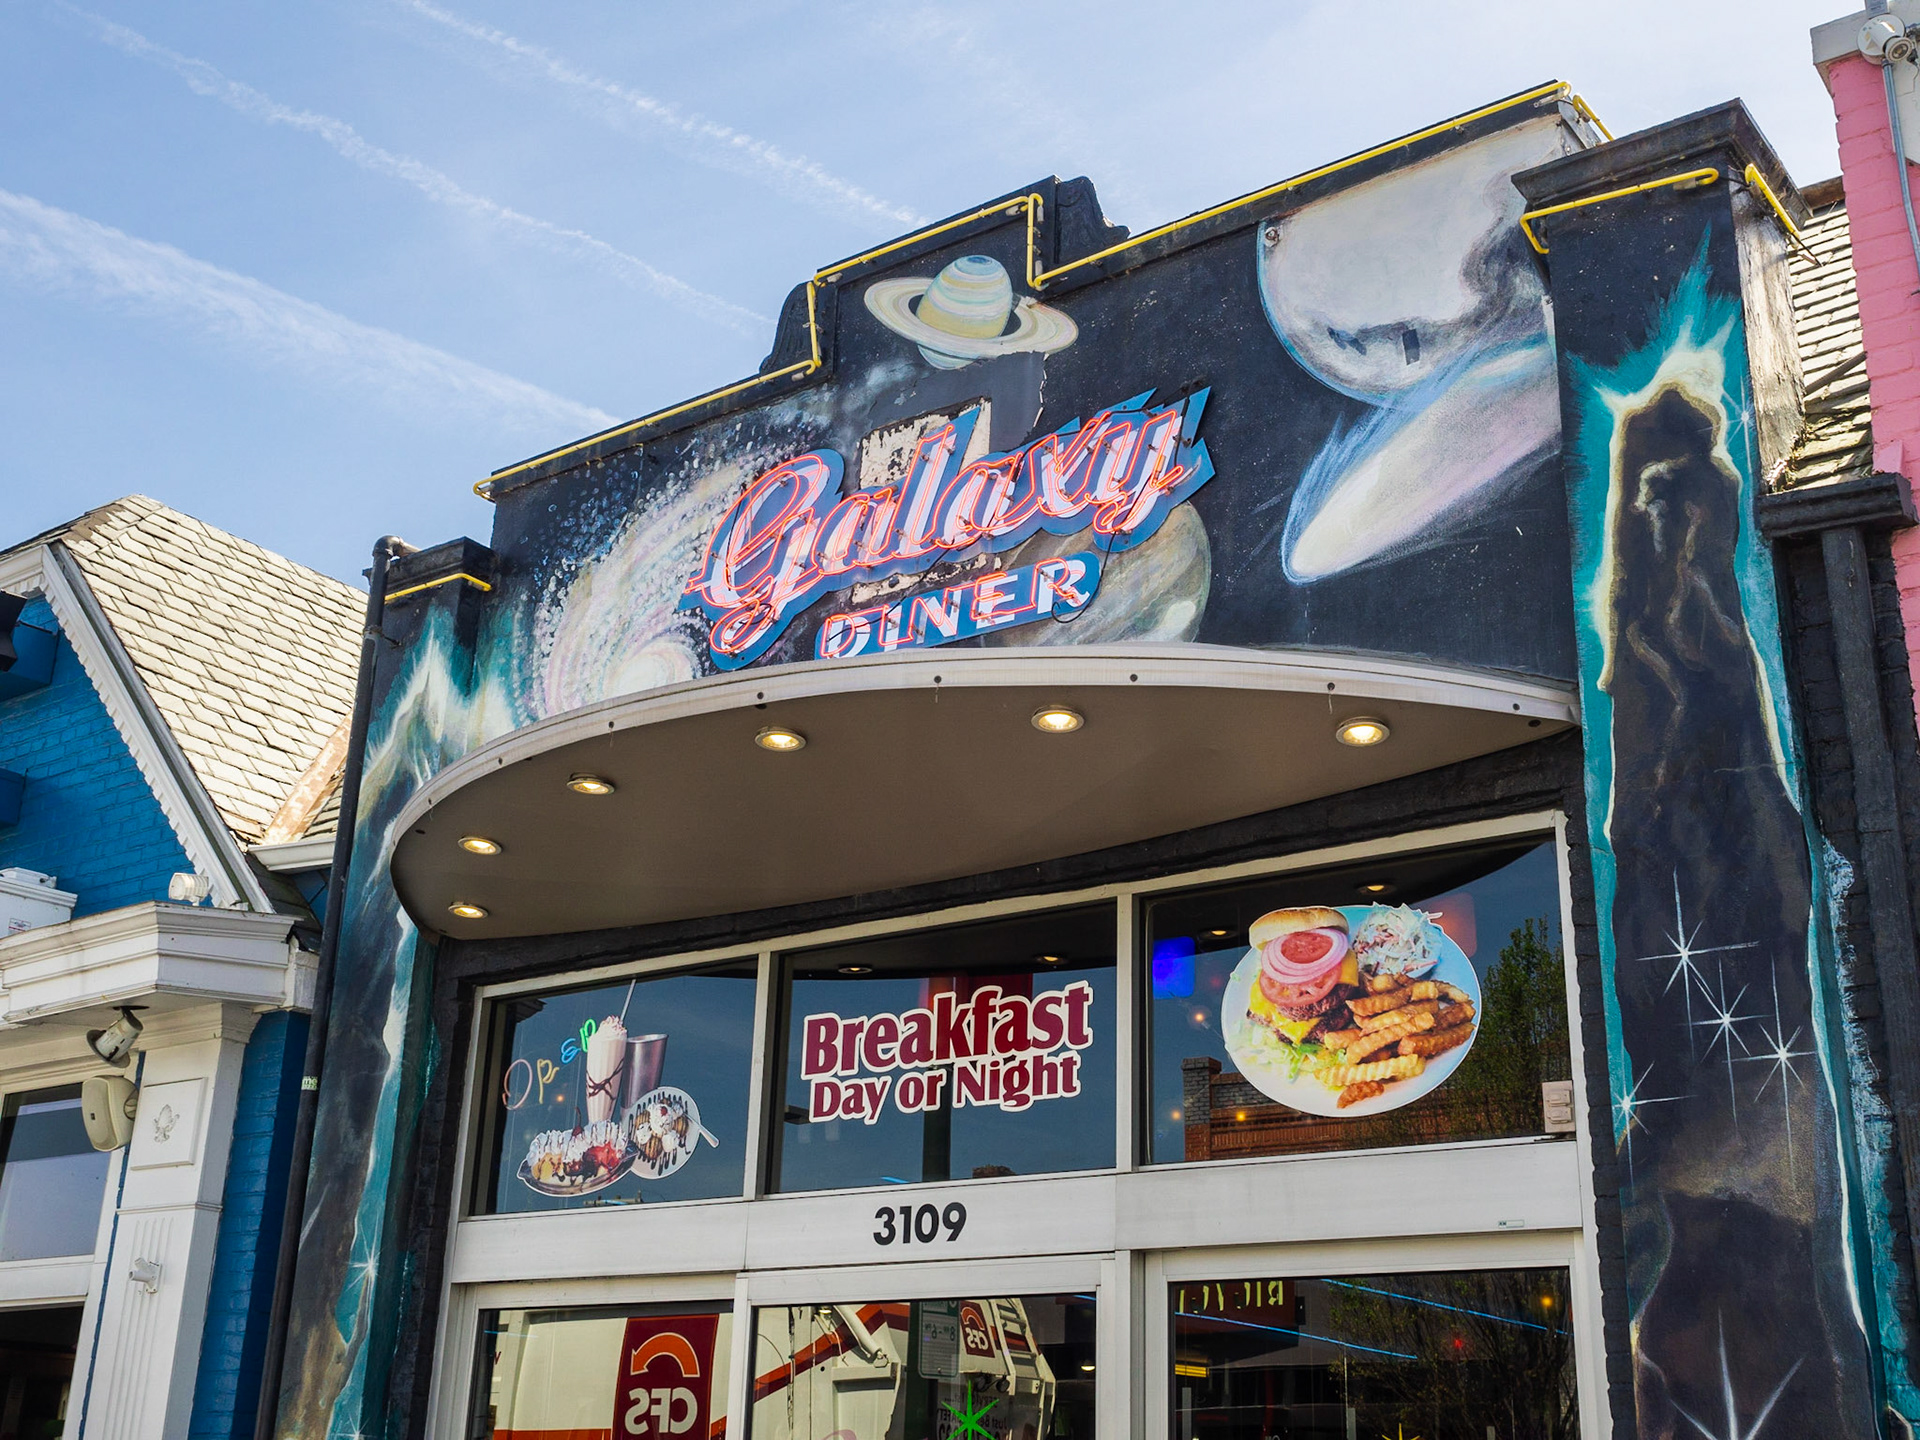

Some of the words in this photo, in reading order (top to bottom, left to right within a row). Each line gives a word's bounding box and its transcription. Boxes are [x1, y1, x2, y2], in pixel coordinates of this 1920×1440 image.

[686, 407, 1198, 657] Galaxy
[819, 553, 1091, 658] DINER
[803, 984, 1091, 1077] Breakfast
[811, 1080, 889, 1121] Day
[897, 1073, 944, 1110] or
[955, 1054, 1078, 1108] Night
[872, 1201, 968, 1246] 3109
